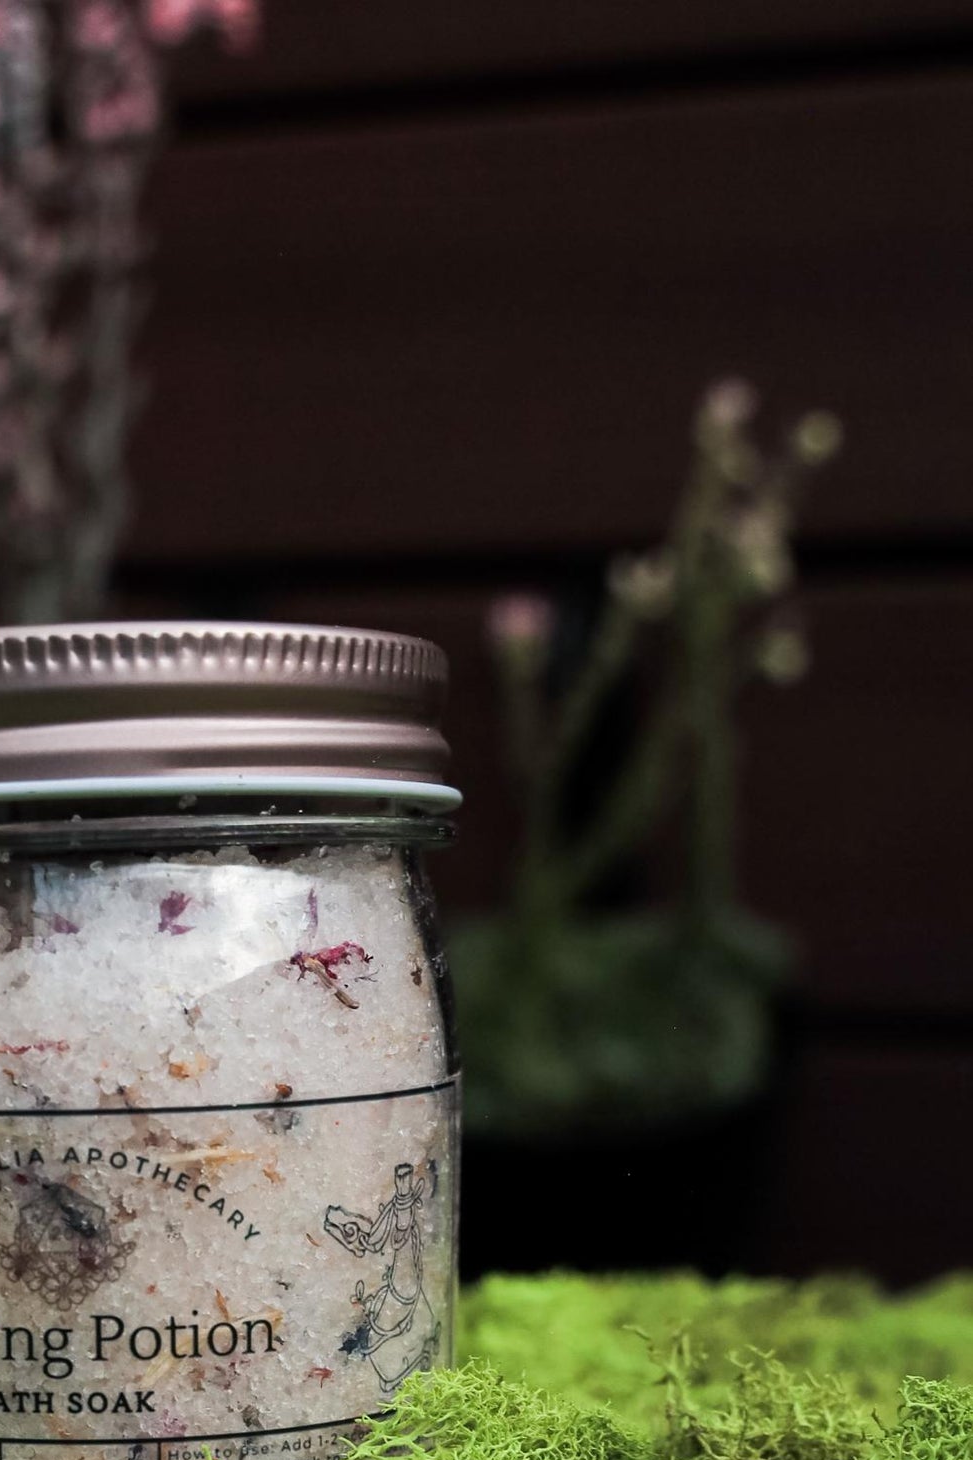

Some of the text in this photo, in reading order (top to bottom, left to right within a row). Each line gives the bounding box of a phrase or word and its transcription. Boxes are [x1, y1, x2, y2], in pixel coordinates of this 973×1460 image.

[62, 1146, 261, 1241] APOTHECARY
[90, 1309, 277, 1362] Potion
[67, 1390, 156, 1415] SOAK
[214, 1447, 233, 1459] to
[281, 1436, 312, 1452] Add
[318, 1433, 338, 1447] 1-2
